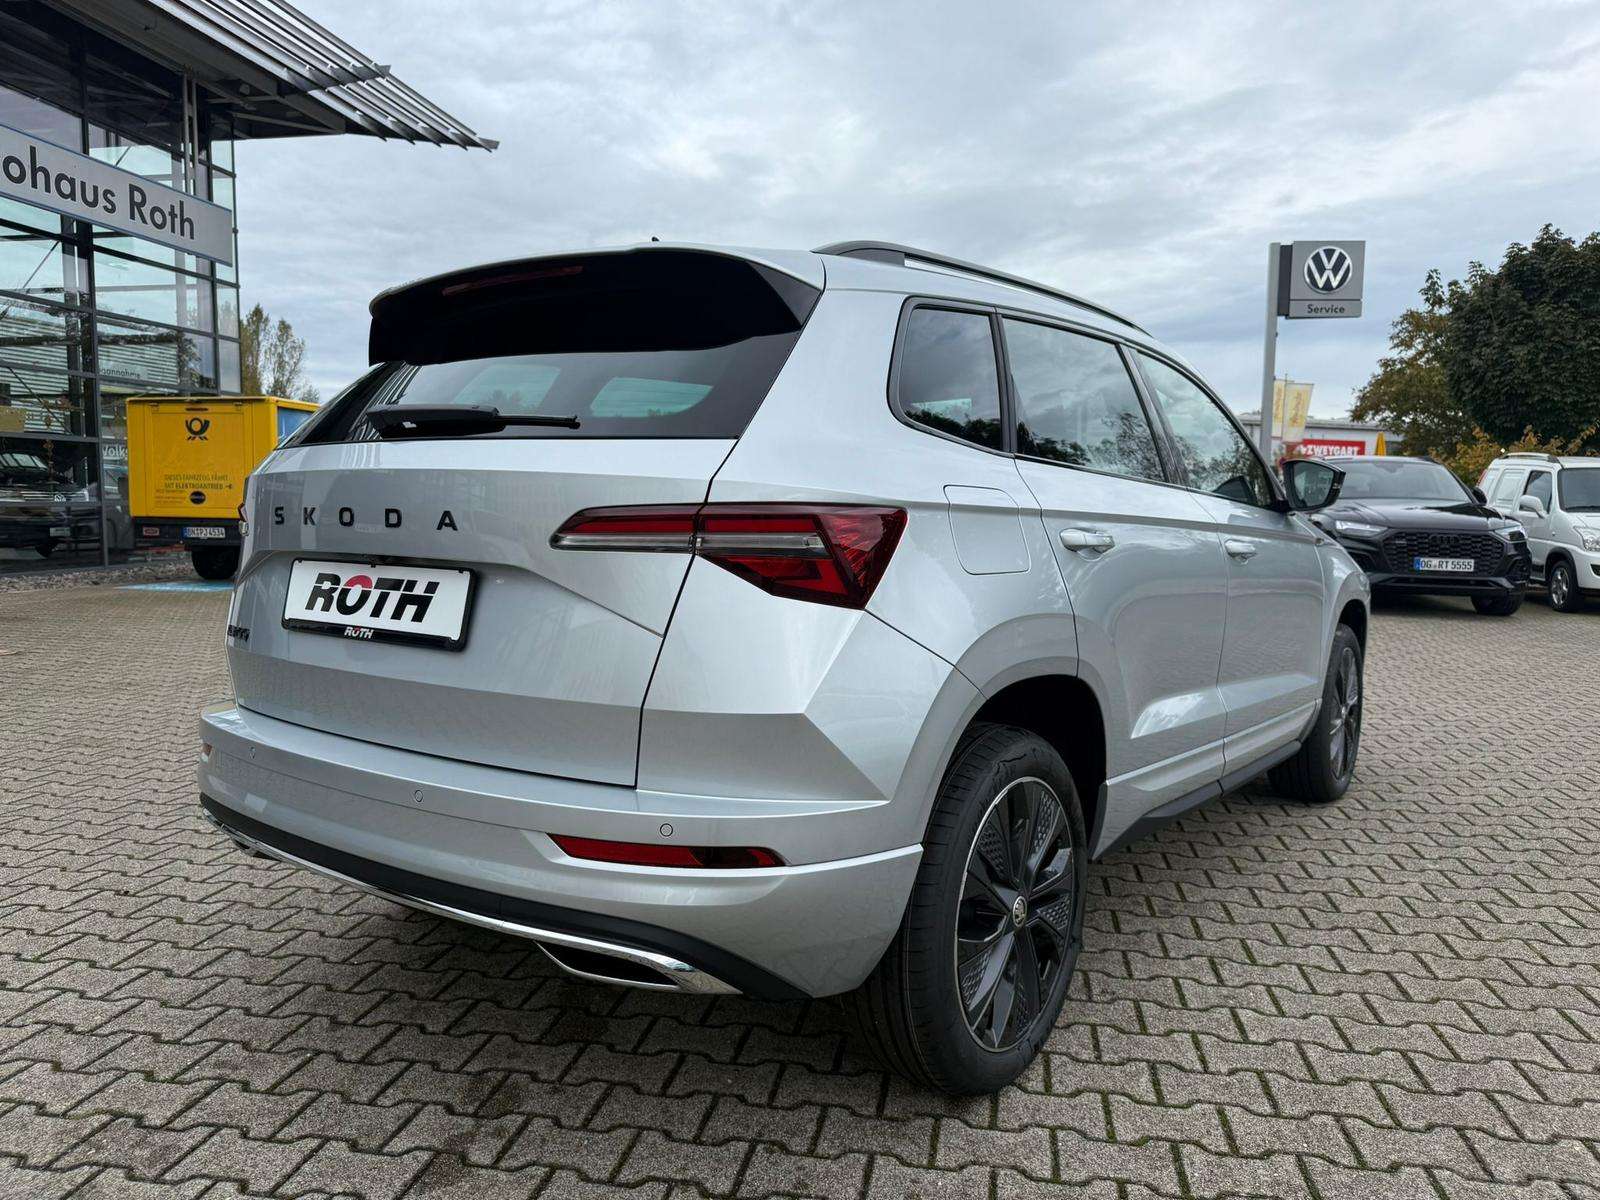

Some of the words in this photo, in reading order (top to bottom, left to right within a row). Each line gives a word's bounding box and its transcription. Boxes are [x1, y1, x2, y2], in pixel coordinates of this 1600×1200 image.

[128, 183, 195, 240] Roth
[1304, 246, 1353, 294] VW
[1307, 303, 1345, 314] Service
[1306, 444, 1360, 456] ZWEYGART
[1420, 560, 1432, 569] OG
[1438, 560, 1450, 570] RT
[1451, 560, 1473, 570] 5555
[304, 572, 441, 623] ROTH
[343, 625, 374, 639] ROTH
